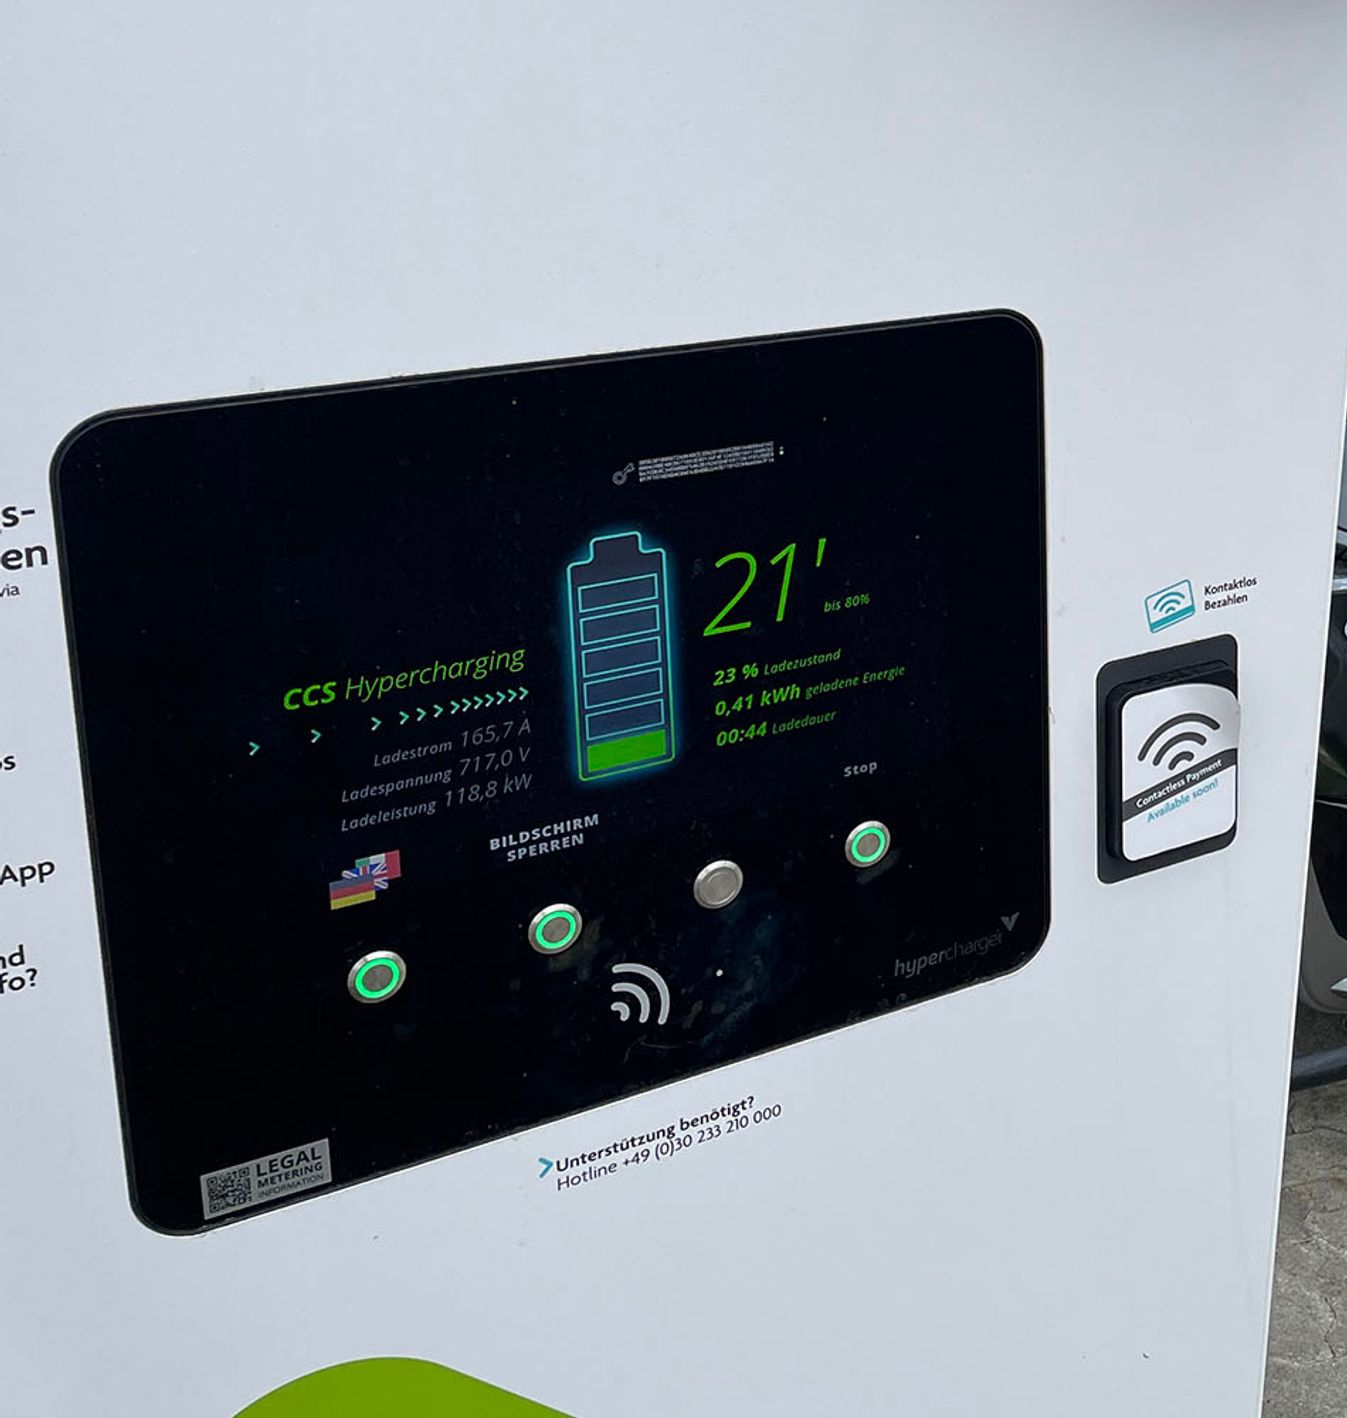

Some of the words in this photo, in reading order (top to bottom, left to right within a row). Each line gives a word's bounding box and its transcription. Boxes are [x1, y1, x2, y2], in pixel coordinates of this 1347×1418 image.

[823, 601, 842, 613] bis
[844, 593, 871, 609] 80%
[1204, 576, 1258, 596] Kontaktlos
[1204, 594, 1248, 611] Bezahlen
[283, 681, 337, 711] CCS
[345, 649, 526, 703] Hypercharging
[713, 668, 736, 687] 23
[742, 662, 759, 680] %
[764, 649, 842, 676] Ladezustand
[714, 694, 753, 717] 0,41
[760, 684, 801, 707] kWh
[805, 676, 860, 700] geladene
[862, 665, 906, 684] Energie
[373, 741, 453, 767] Ladestrom
[460, 720, 514, 748] 165,7
[517, 718, 532, 736] A
[716, 721, 767, 747] 00:44
[772, 710, 837, 735] Ladedauer
[341, 768, 452, 803] Ladespannung
[459, 750, 514, 777] 717,0
[519, 746, 532, 762] V
[1135, 776, 1186, 808] Contactless
[1185, 759, 1222, 783] Payment
[341, 800, 437, 832] Ladeleistung
[445, 780, 498, 807] 118,8
[503, 773, 533, 793] kW
[1146, 793, 1191, 823] Available
[1192, 778, 1219, 799] soon!
[489, 813, 599, 851] BILDSCHIRM
[507, 832, 585, 862] SPERREN
[894, 929, 1004, 979] hypercharger
[555, 1122, 677, 1173] Unterstützung
[679, 1095, 755, 1133] benötigt?
[556, 1161, 618, 1192] Hotline
[622, 1149, 652, 1168] +49
[654, 1134, 693, 1162] (0)30
[697, 1124, 723, 1145] 233
[726, 1115, 749, 1134] 210
[753, 1103, 782, 1125] 000
[256, 1147, 323, 1178] LEGAL
[257, 1161, 324, 1189] METERING
[258, 1173, 325, 1199] INFORMATION
